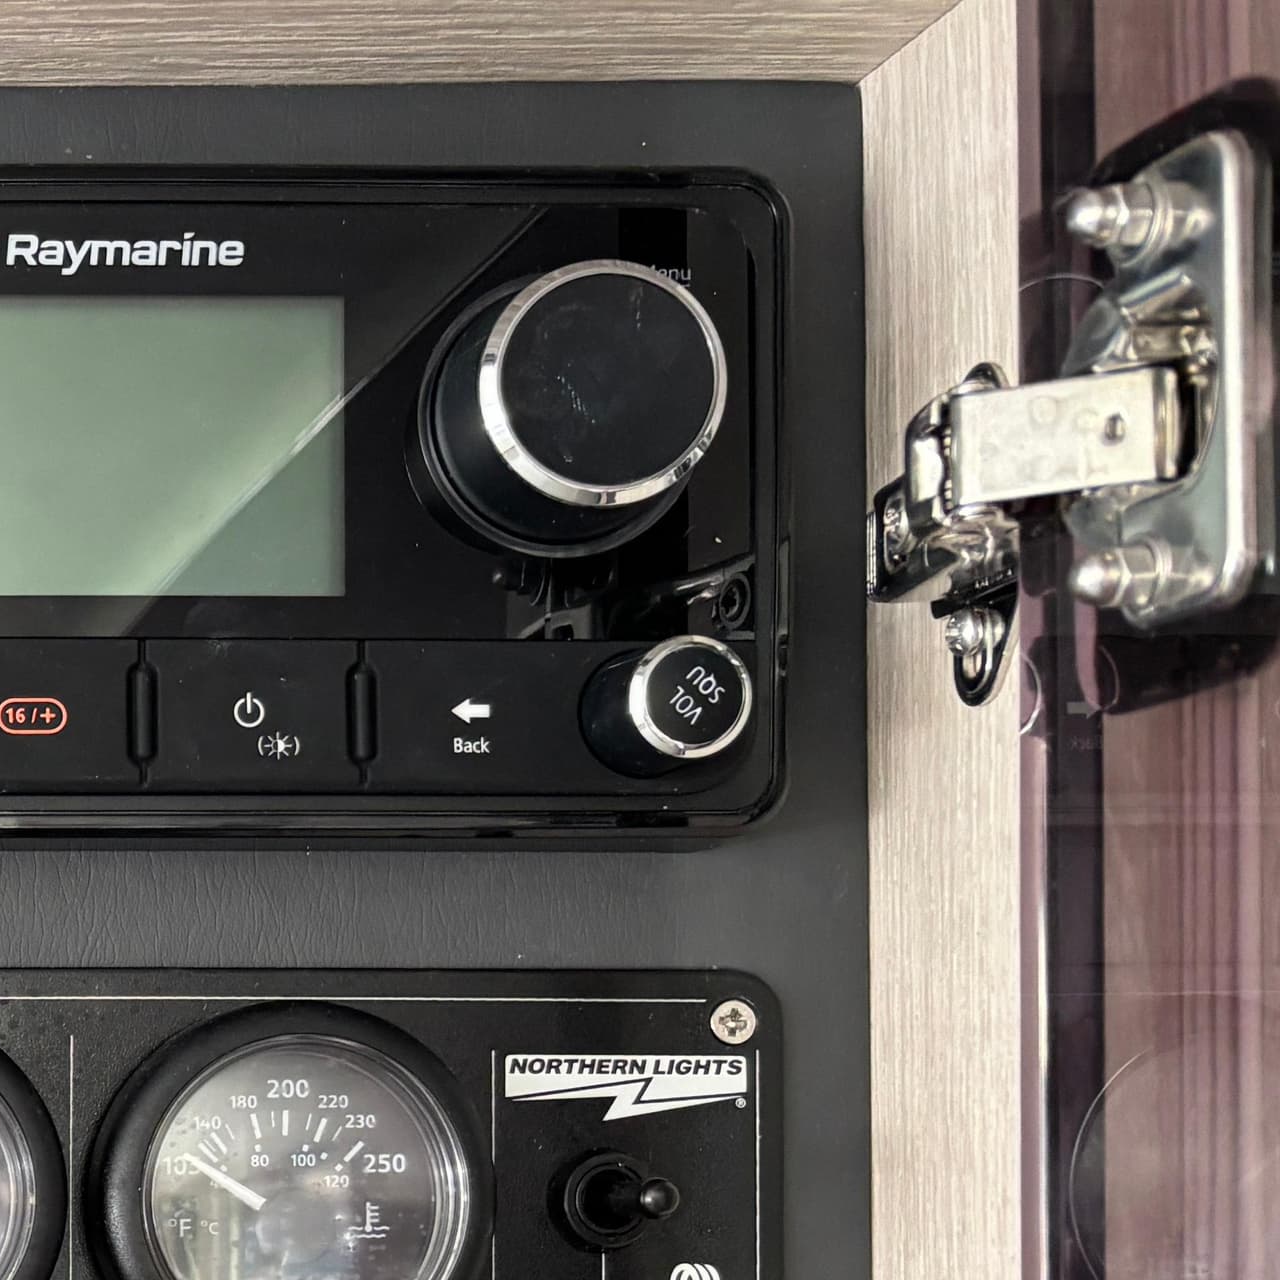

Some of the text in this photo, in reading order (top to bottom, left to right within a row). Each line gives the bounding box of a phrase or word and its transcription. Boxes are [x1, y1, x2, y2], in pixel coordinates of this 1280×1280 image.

[7, 233, 244, 275] Raymarine
[669, 685, 702, 725] VOL
[454, 737, 489, 753] Back
[510, 1059, 742, 1075] NORTHERN LIGHTS
[267, 1080, 309, 1098] 200
[230, 1096, 257, 1108] 180
[318, 1095, 348, 1108] 220
[345, 1115, 375, 1128] 230
[364, 1154, 405, 1172] 250
